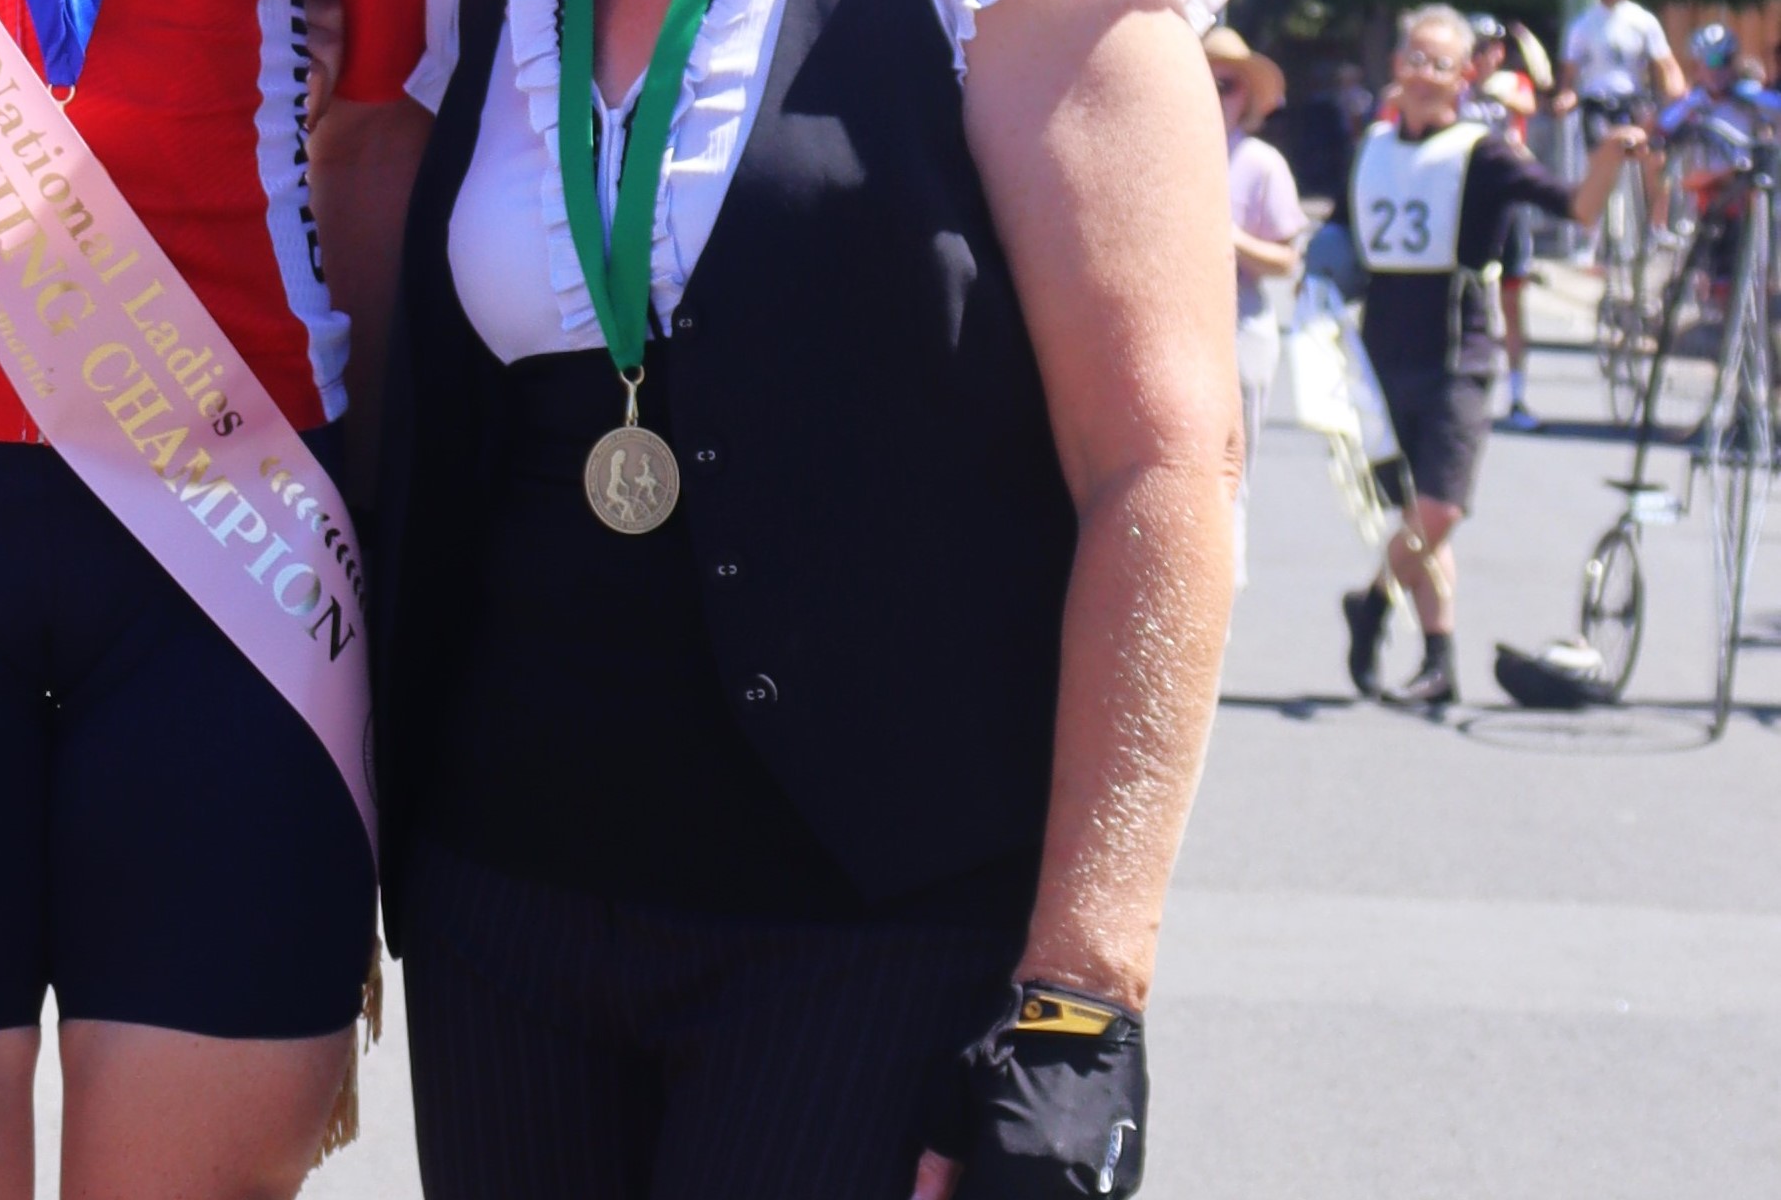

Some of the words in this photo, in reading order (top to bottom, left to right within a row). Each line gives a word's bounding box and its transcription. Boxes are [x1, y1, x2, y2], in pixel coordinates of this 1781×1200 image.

[1370, 199, 1431, 255] 23
[121, 278, 244, 438] Ladies
[82, 341, 356, 662] CHAMPION
